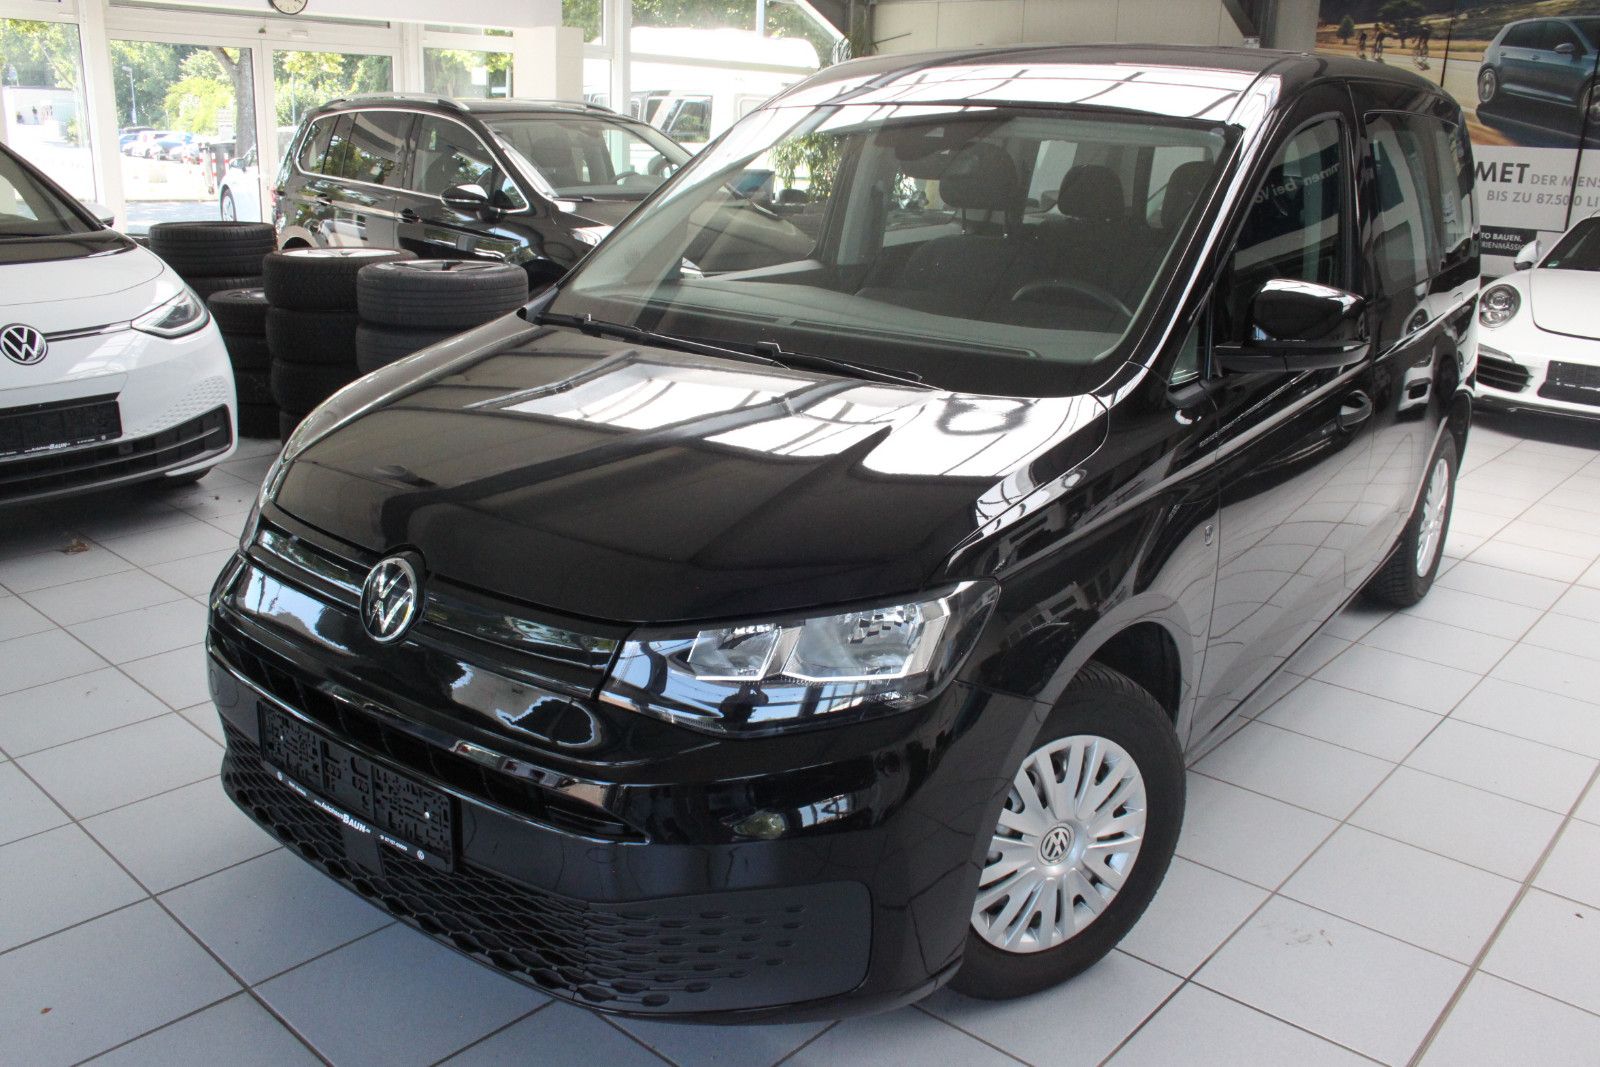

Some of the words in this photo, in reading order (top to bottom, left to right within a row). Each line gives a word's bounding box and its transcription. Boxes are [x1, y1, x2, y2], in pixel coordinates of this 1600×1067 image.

[1475, 161, 1530, 184] MET
[1530, 174, 1557, 187] DER
[1487, 190, 1508, 202] BIS
[1512, 191, 1532, 203] ZU
